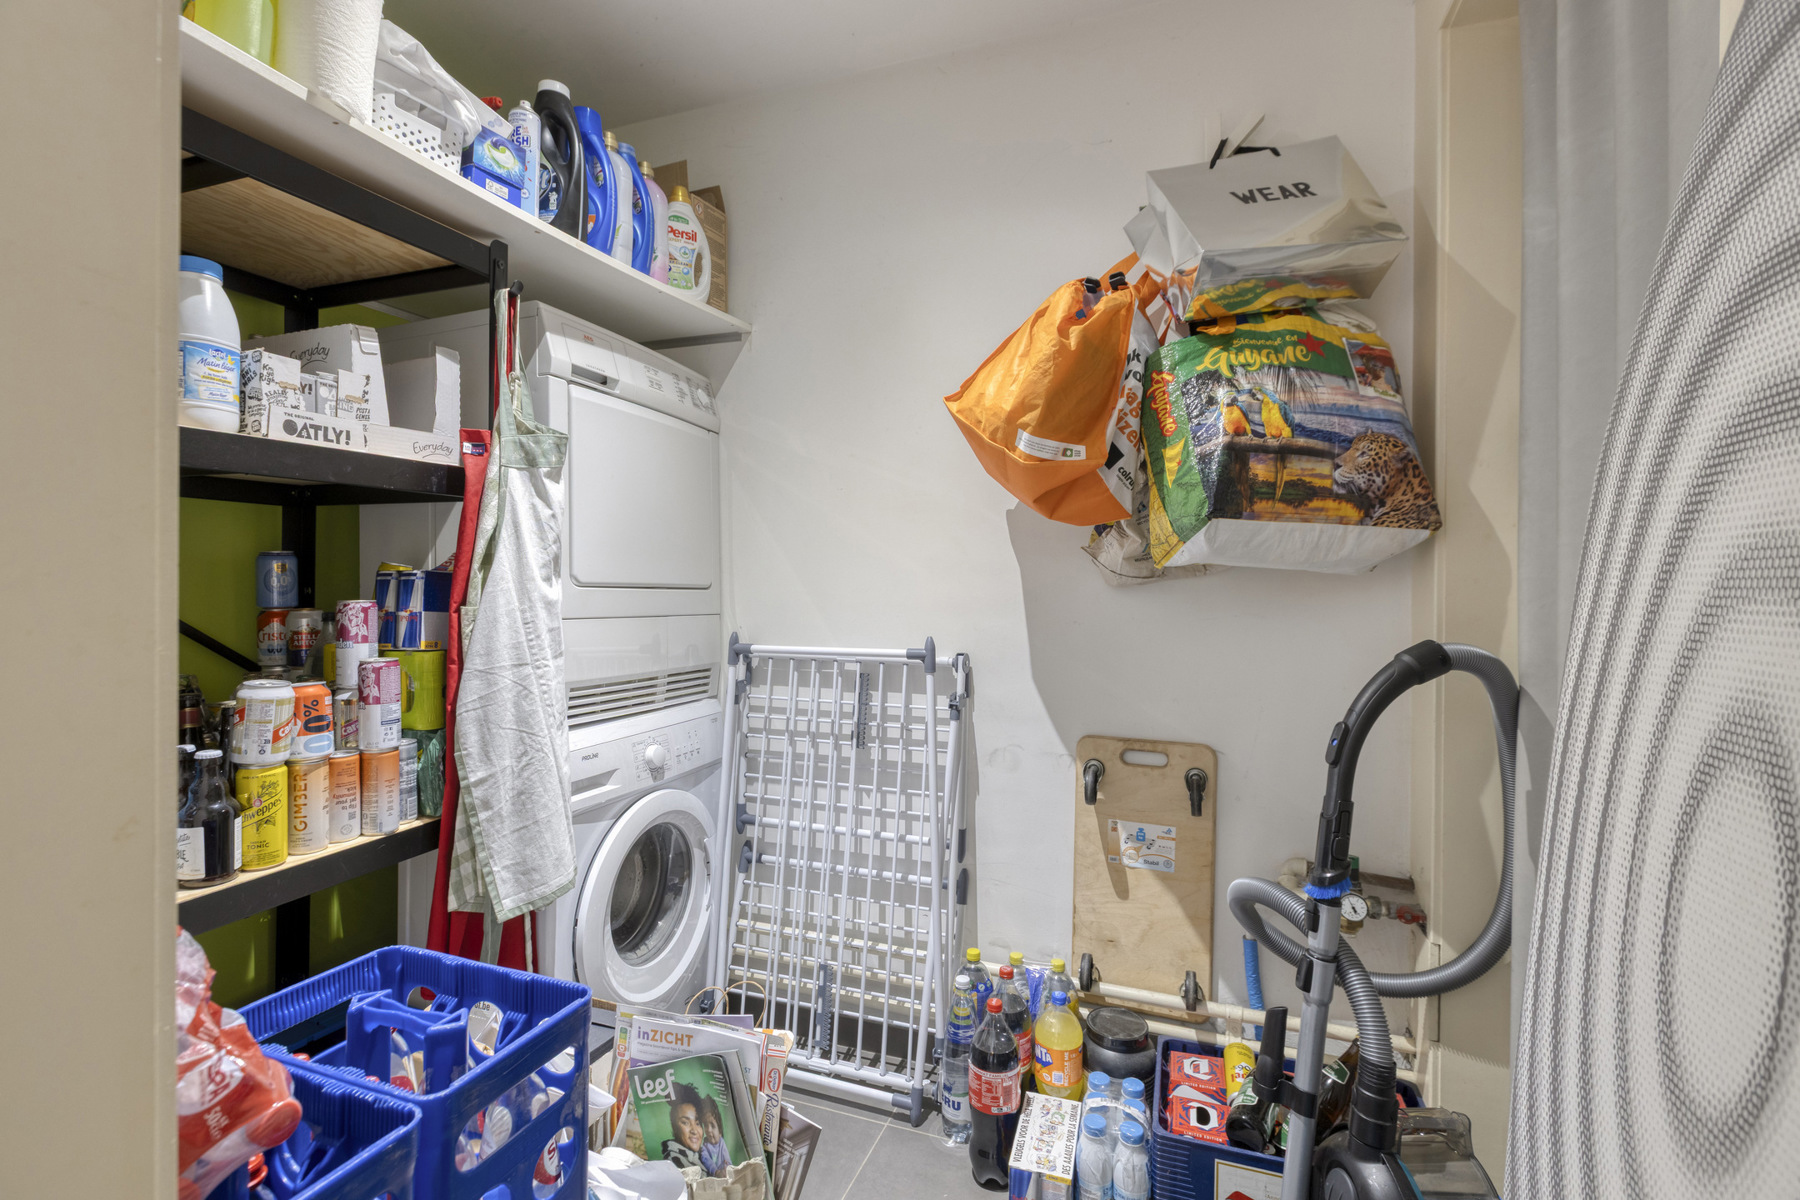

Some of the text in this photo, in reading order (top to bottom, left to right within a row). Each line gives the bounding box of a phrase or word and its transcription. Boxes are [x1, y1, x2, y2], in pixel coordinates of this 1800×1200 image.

[1228, 182, 1319, 204] WEAR
[668, 225, 697, 243] Persil
[1285, 335, 1298, 343] en
[197, 357, 220, 369] Matin
[1195, 344, 1312, 378] Guyane
[1147, 371, 1177, 435] Guyane
[283, 418, 351, 446] OATLY!
[413, 441, 454, 456] Everyday
[582, 752, 599, 762] PROLINE
[293, 773, 308, 832] GIMBER
[637, 1026, 694, 1047] inZICHT
[762, 1093, 779, 1146] Ristorante
[1021, 1117, 1030, 1125] DE
[1067, 1122, 1076, 1130] LA
[1018, 1124, 1029, 1139] VOOR
[1065, 1129, 1077, 1143] POUR
[1204, 1134, 1222, 1142] EDITION
[1061, 1164, 1072, 1176] DES
